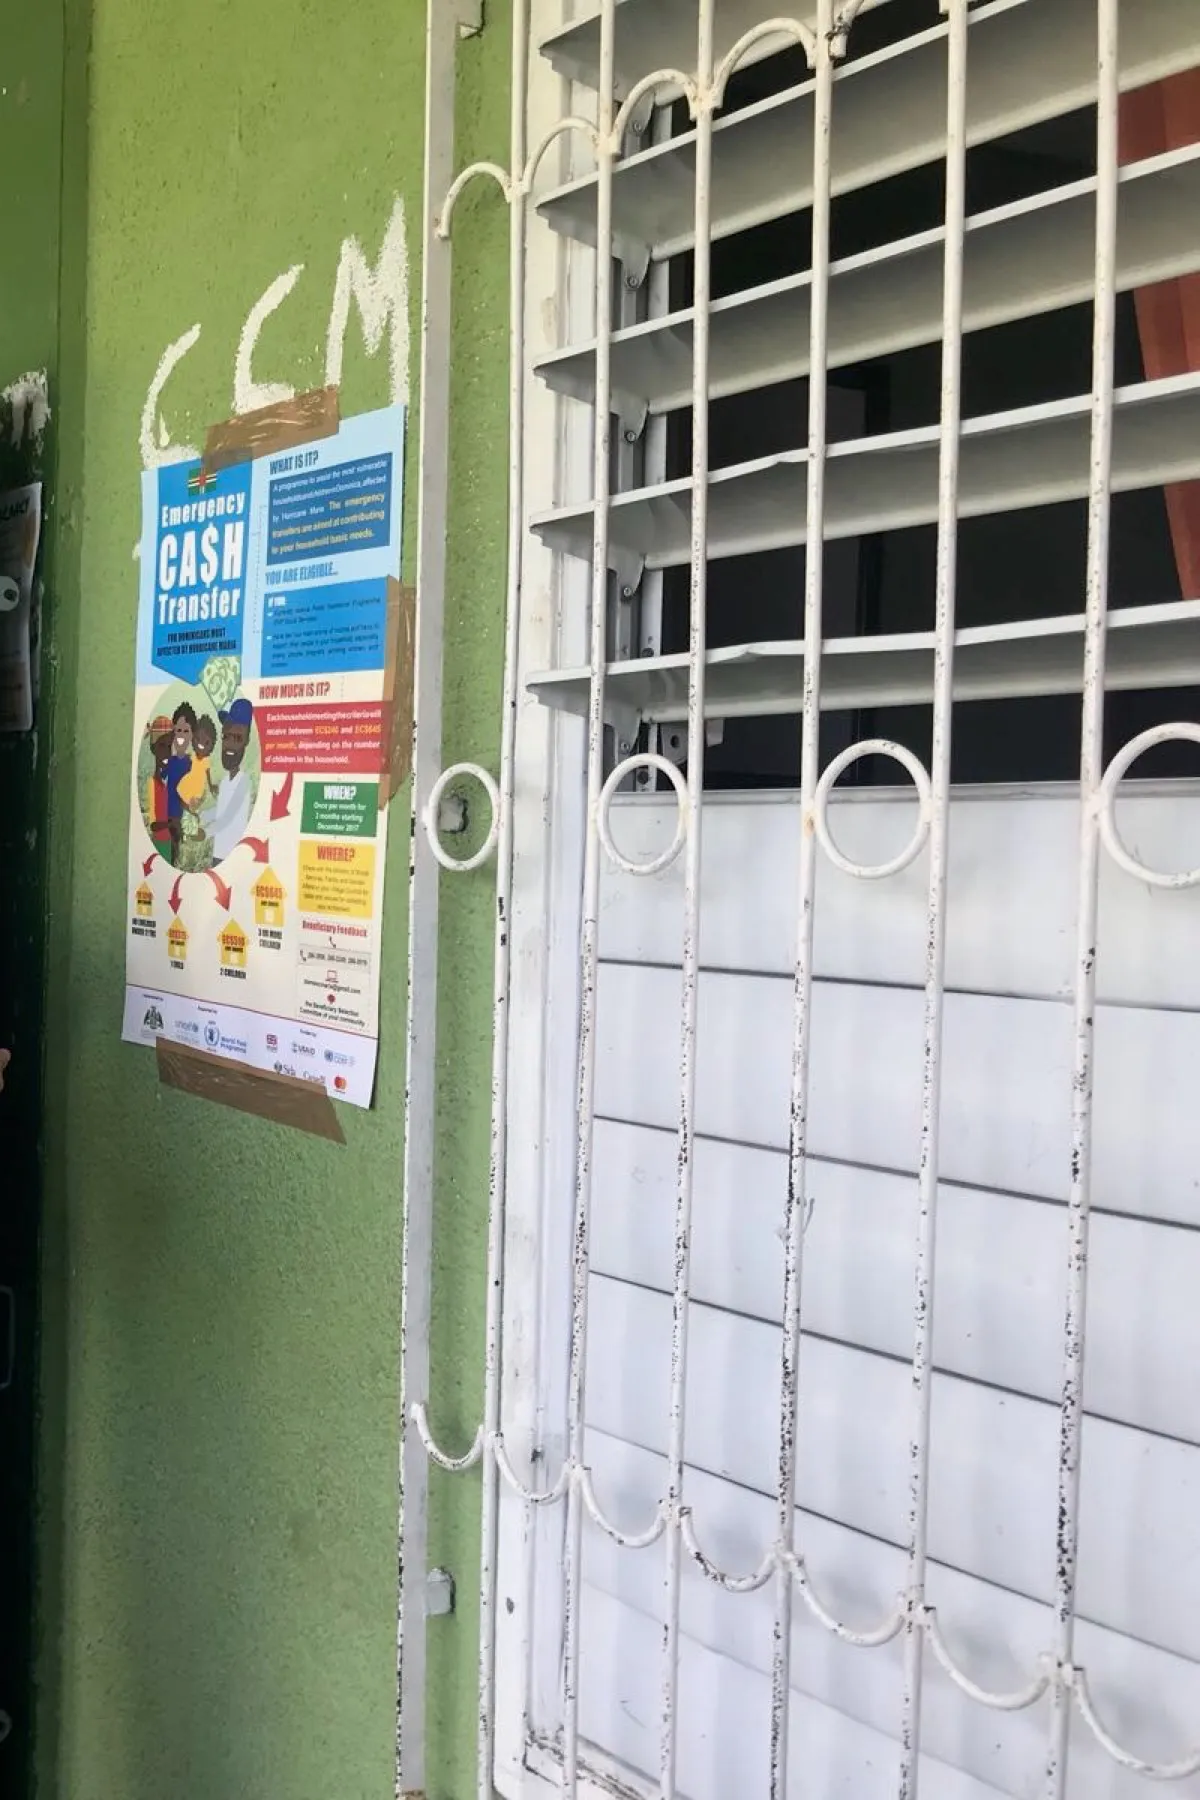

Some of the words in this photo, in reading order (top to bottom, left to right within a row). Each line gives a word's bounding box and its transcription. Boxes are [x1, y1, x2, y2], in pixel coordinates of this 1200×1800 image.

[270, 457, 293, 475] WHAT
[295, 454, 303, 469] IS
[305, 450, 319, 466] IT?
[344, 493, 385, 509] emergency
[161, 492, 246, 528] Emergency
[340, 510, 385, 525] contributing
[295, 537, 329, 550] household
[159, 521, 245, 592] CA$H
[266, 572, 280, 585] YOU
[283, 568, 298, 582] ARE
[158, 586, 241, 625] Transfer
[259, 685, 279, 699] HOW
[280, 683, 304, 698] MUCH
[306, 683, 314, 697] IS
[316, 681, 330, 696] IT?
[340, 725, 353, 734] and
[298, 741, 331, 751] depending
[341, 740, 352, 749] the
[272, 755, 296, 763] children
[304, 755, 313, 763] the
[323, 785, 357, 801] WHEN?
[317, 845, 356, 862] WHERE?
[303, 920, 337, 934] Beneficiary
[337, 925, 367, 937] Feedback
